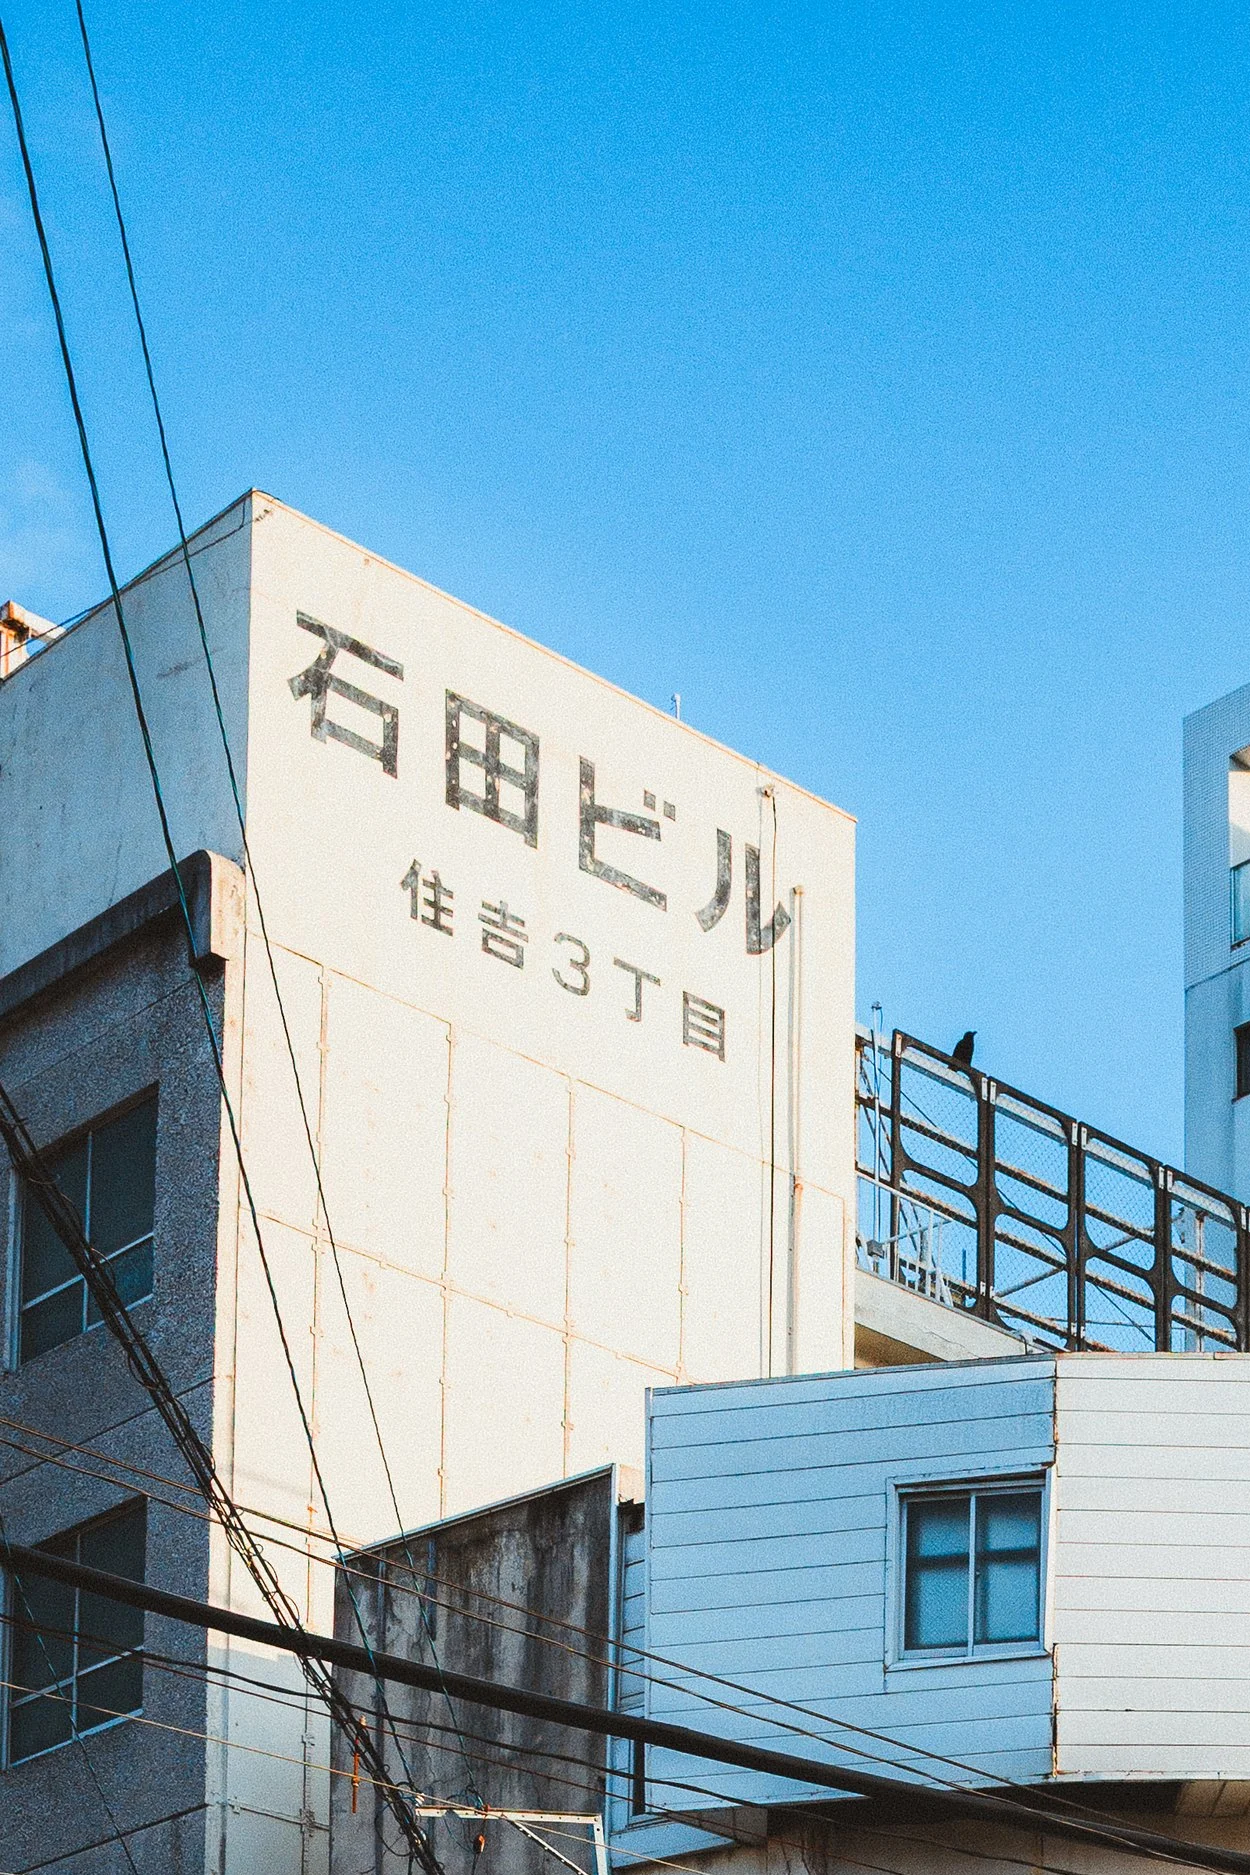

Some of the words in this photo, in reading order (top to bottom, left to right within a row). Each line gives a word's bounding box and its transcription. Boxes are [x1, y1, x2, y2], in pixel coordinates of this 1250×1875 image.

[287, 609, 792, 956] 石田ビル
[400, 859, 727, 1063] 住吉3丁目
